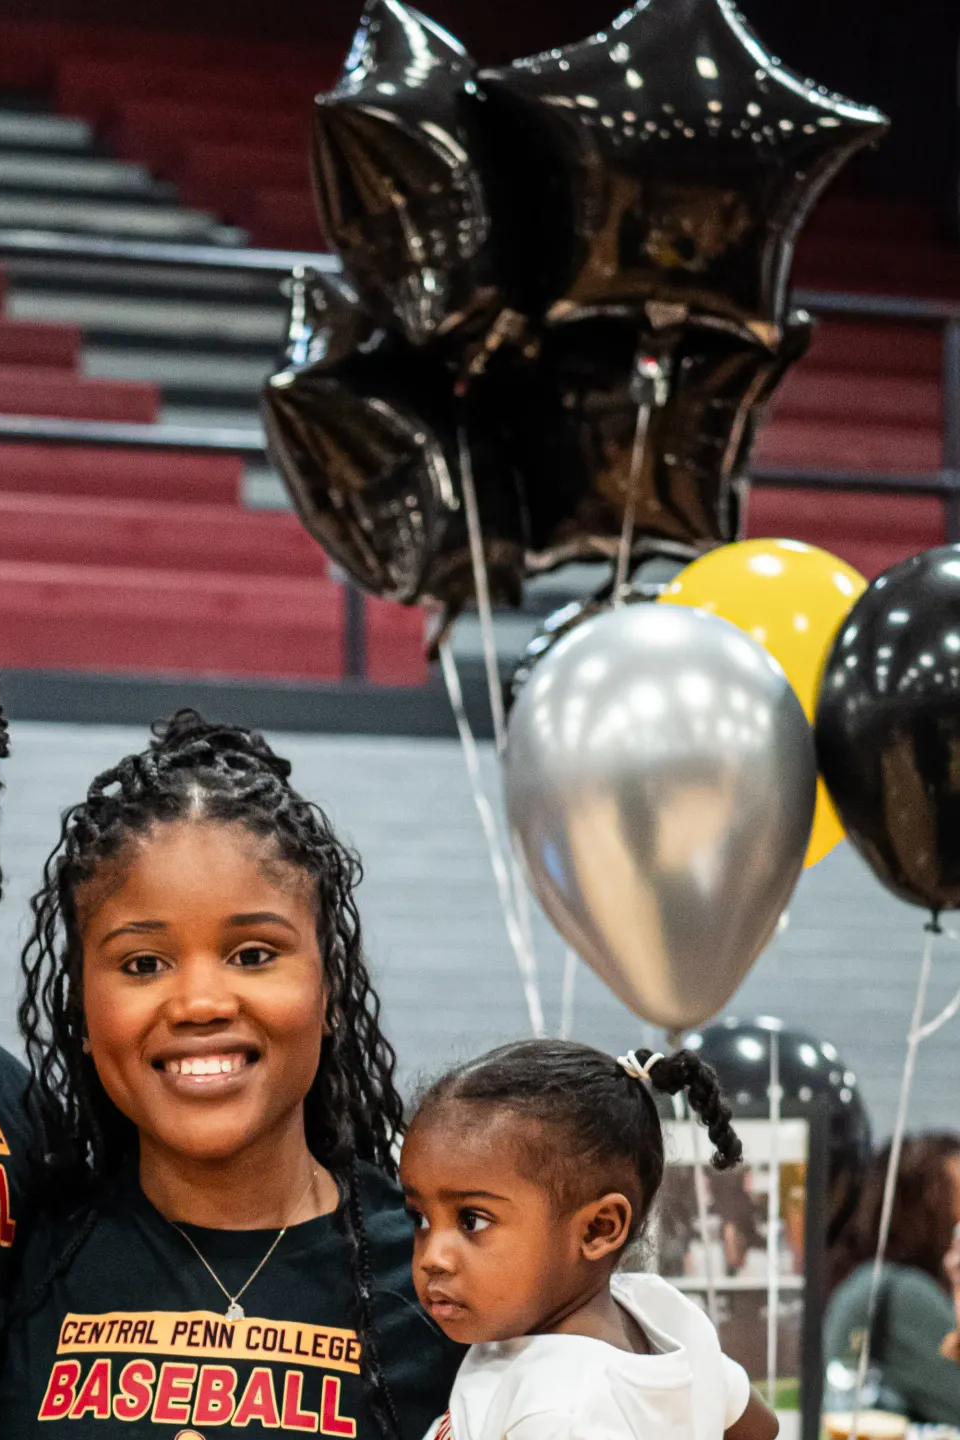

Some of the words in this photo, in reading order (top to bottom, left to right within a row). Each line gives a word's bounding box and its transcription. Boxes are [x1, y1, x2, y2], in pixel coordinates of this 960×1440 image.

[60, 1319, 159, 1346] CENTRAL
[170, 1320, 235, 1349] PENN
[245, 1325, 361, 1365] COLLEGE
[37, 1358, 357, 1438] BASEBALL
